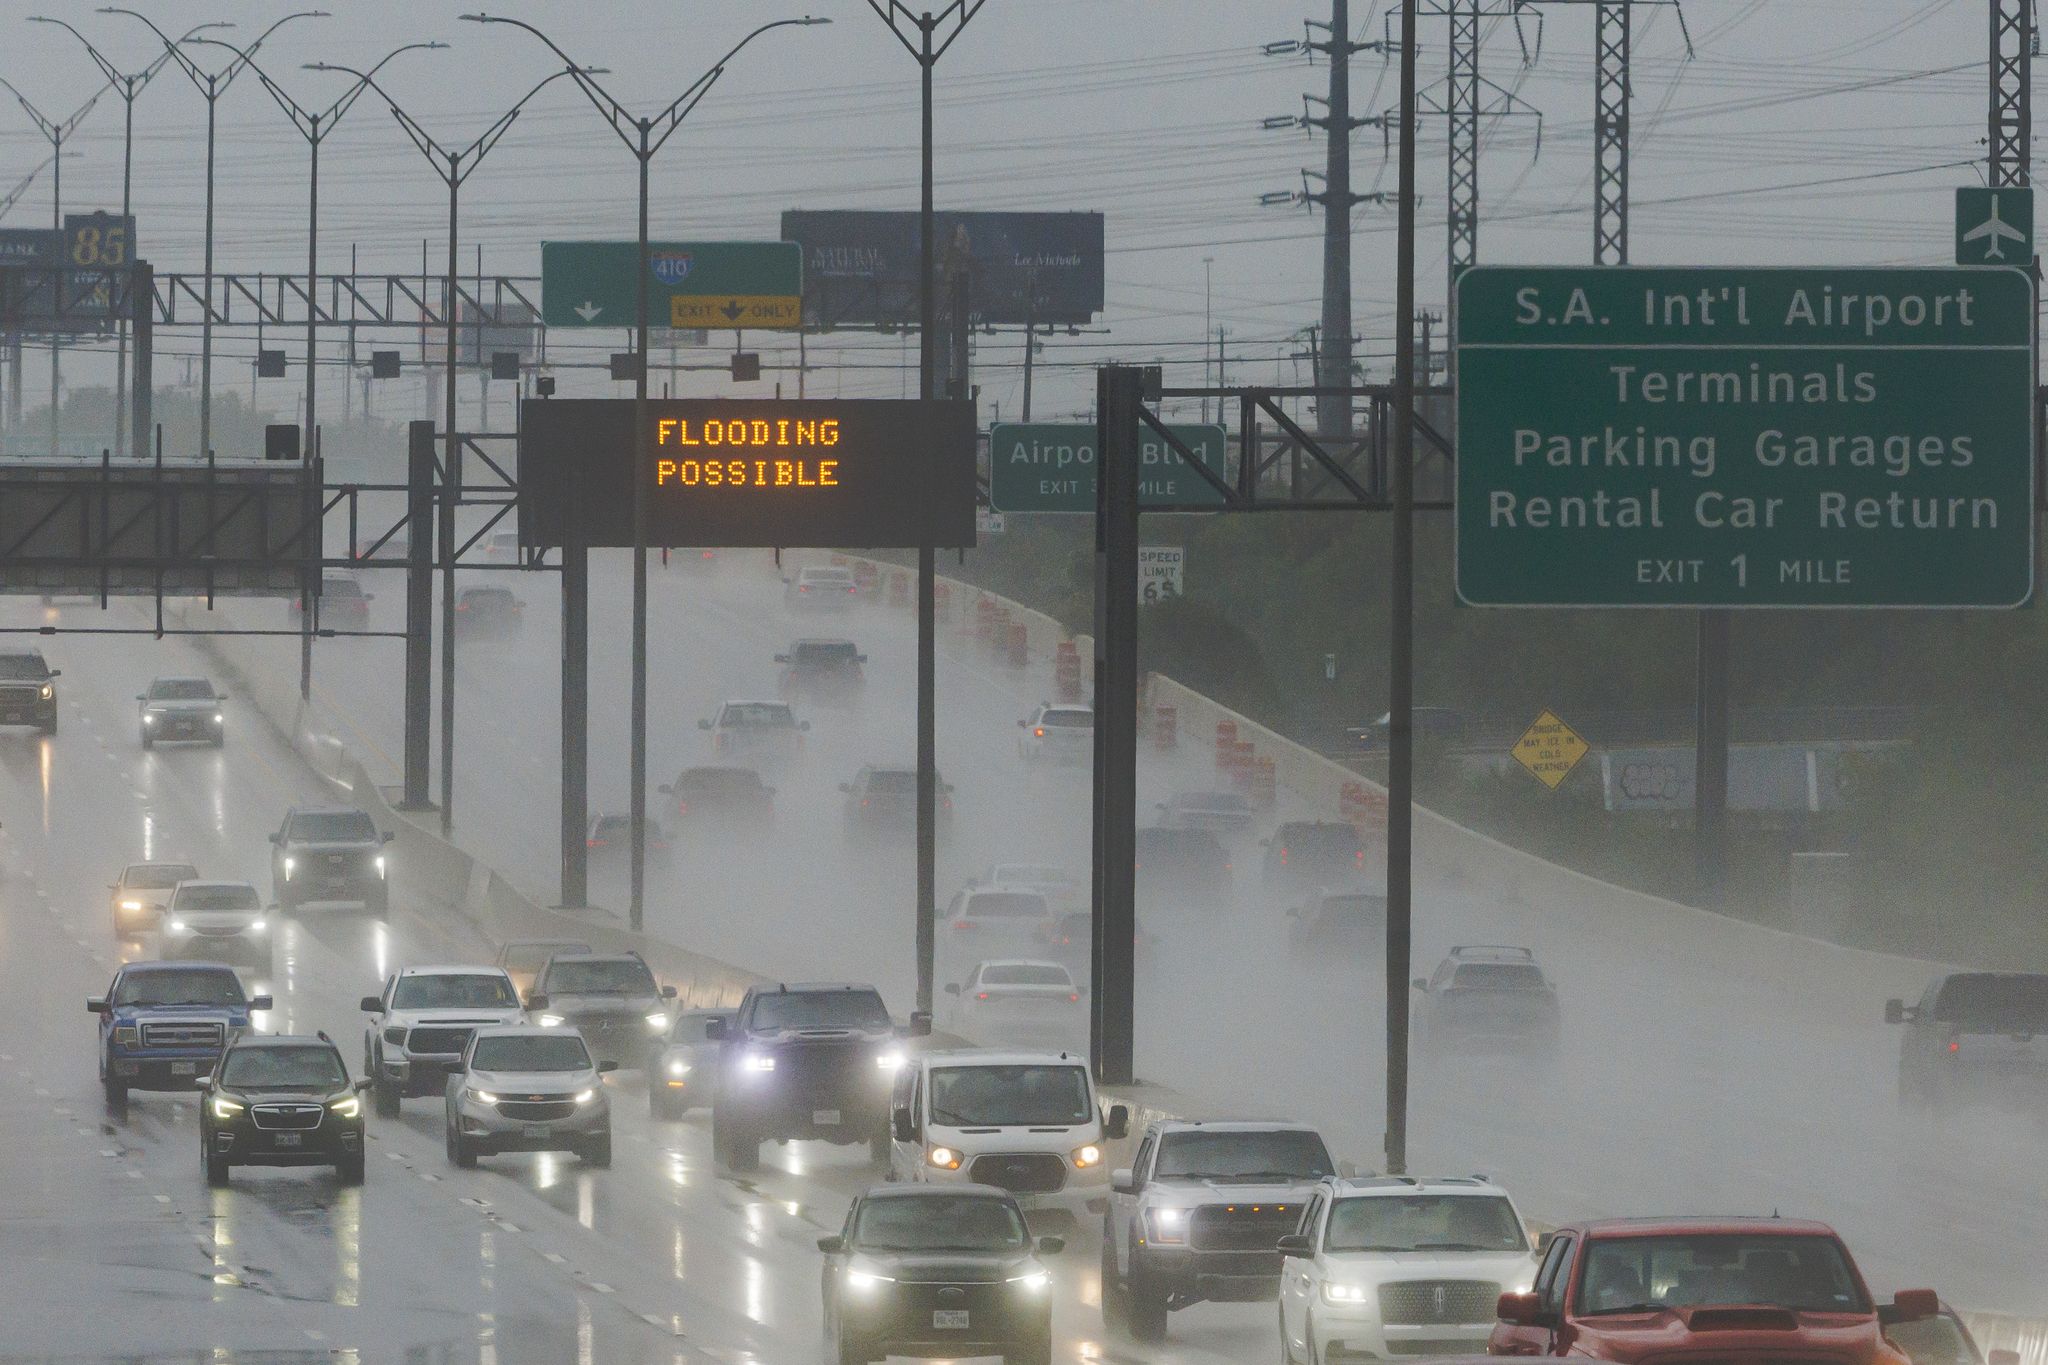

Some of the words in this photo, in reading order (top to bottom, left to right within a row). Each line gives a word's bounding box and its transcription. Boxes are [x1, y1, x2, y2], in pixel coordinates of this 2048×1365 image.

[74, 226, 125, 266] 85
[656, 259, 688, 277] 410
[677, 304, 713, 318] EXIT
[751, 304, 796, 319] ONLY
[1515, 287, 1611, 326] S.A.
[1645, 286, 1751, 326] Int'l
[1784, 285, 1975, 337] Airport
[1609, 362, 1878, 404] Terminals
[658, 419, 839, 446] FLOODING
[1010, 439, 1095, 469] Airpo
[1514, 426, 1717, 478] Parking
[1755, 429, 1975, 478] Garages
[657, 460, 839, 486] POSSIBLE
[1039, 479, 1079, 496] EXIT
[1488, 488, 1665, 529] Rental
[1694, 490, 1786, 530] Car
[1819, 490, 1999, 530] Return
[1140, 552, 1181, 563] SPEED
[1636, 559, 1704, 584] EXIT
[1730, 553, 1748, 588] 1
[1779, 559, 1852, 584] MILE
[1144, 567, 1176, 578] LIMIT
[1143, 581, 1174, 600] 65
[1523, 738, 1541, 749] MAY
[1547, 736, 1560, 747] ICE
[1566, 735, 1575, 745] IN
[1532, 761, 1570, 773] WEATHER
